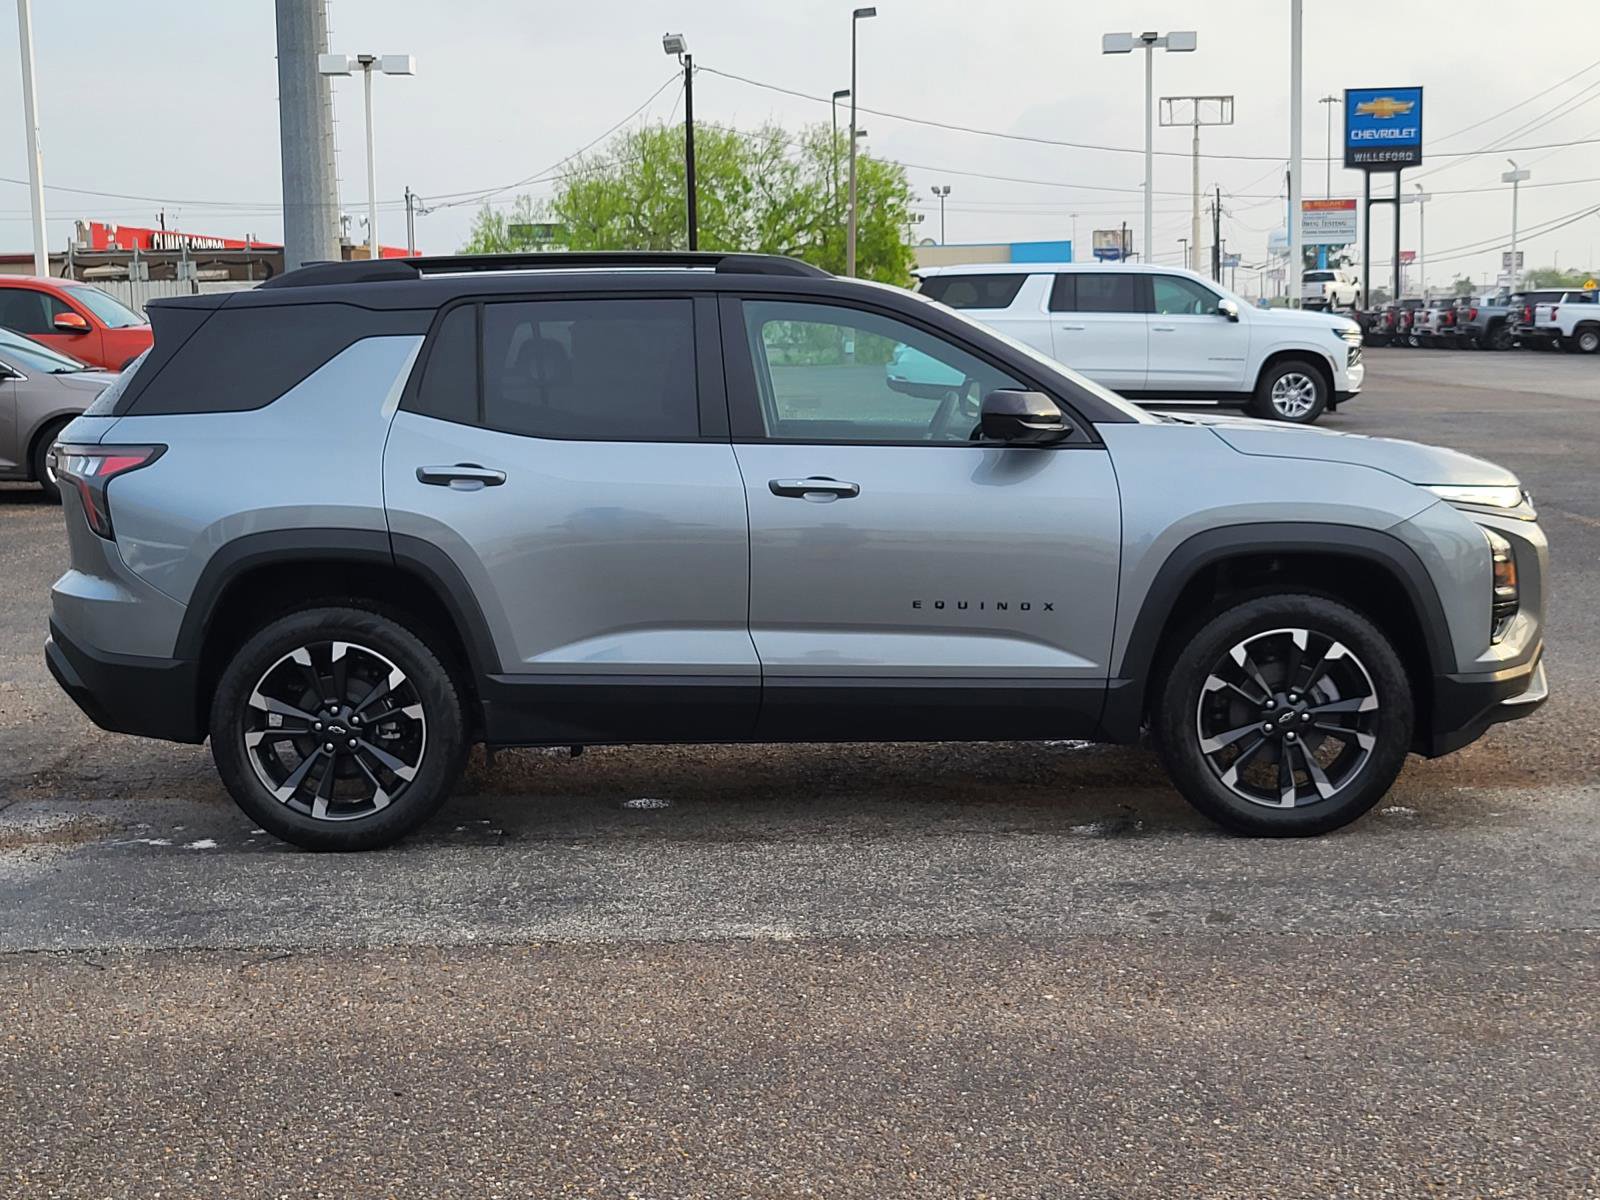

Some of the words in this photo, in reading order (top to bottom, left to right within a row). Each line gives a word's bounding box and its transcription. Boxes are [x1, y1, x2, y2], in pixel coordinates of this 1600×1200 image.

[1351, 128, 1416, 140] CHEVROLET
[1354, 152, 1413, 162] WILLEFORD
[912, 600, 1055, 611] EQUINOX
